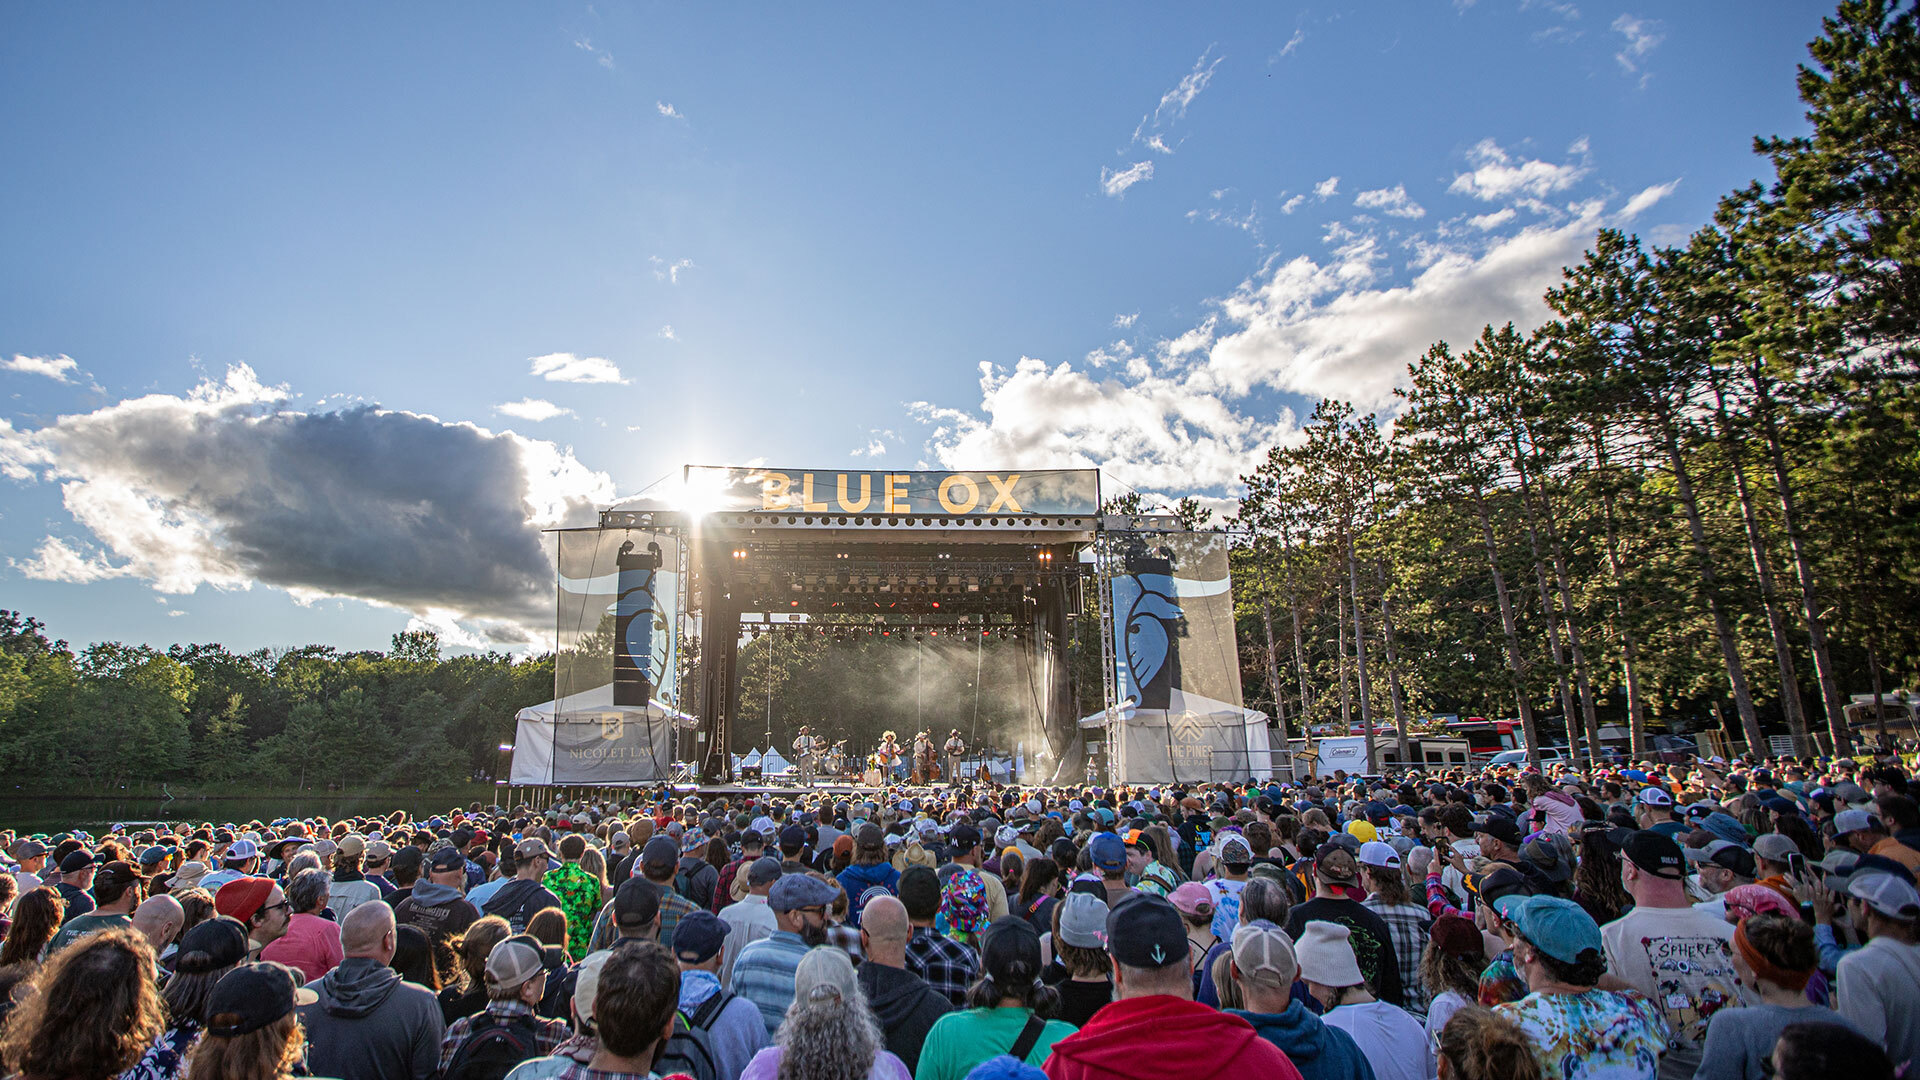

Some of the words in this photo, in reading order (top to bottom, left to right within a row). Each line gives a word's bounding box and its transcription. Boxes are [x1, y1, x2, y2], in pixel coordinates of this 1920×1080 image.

[763, 472, 911, 514] BLUE
[938, 474, 1023, 514] OX
[569, 747, 627, 759] NICOLET
[631, 747, 657, 757] LAW
[1166, 745, 1184, 758] THE
[1186, 745, 1214, 758] PINES
[1659, 943, 1716, 958] SPHERE
